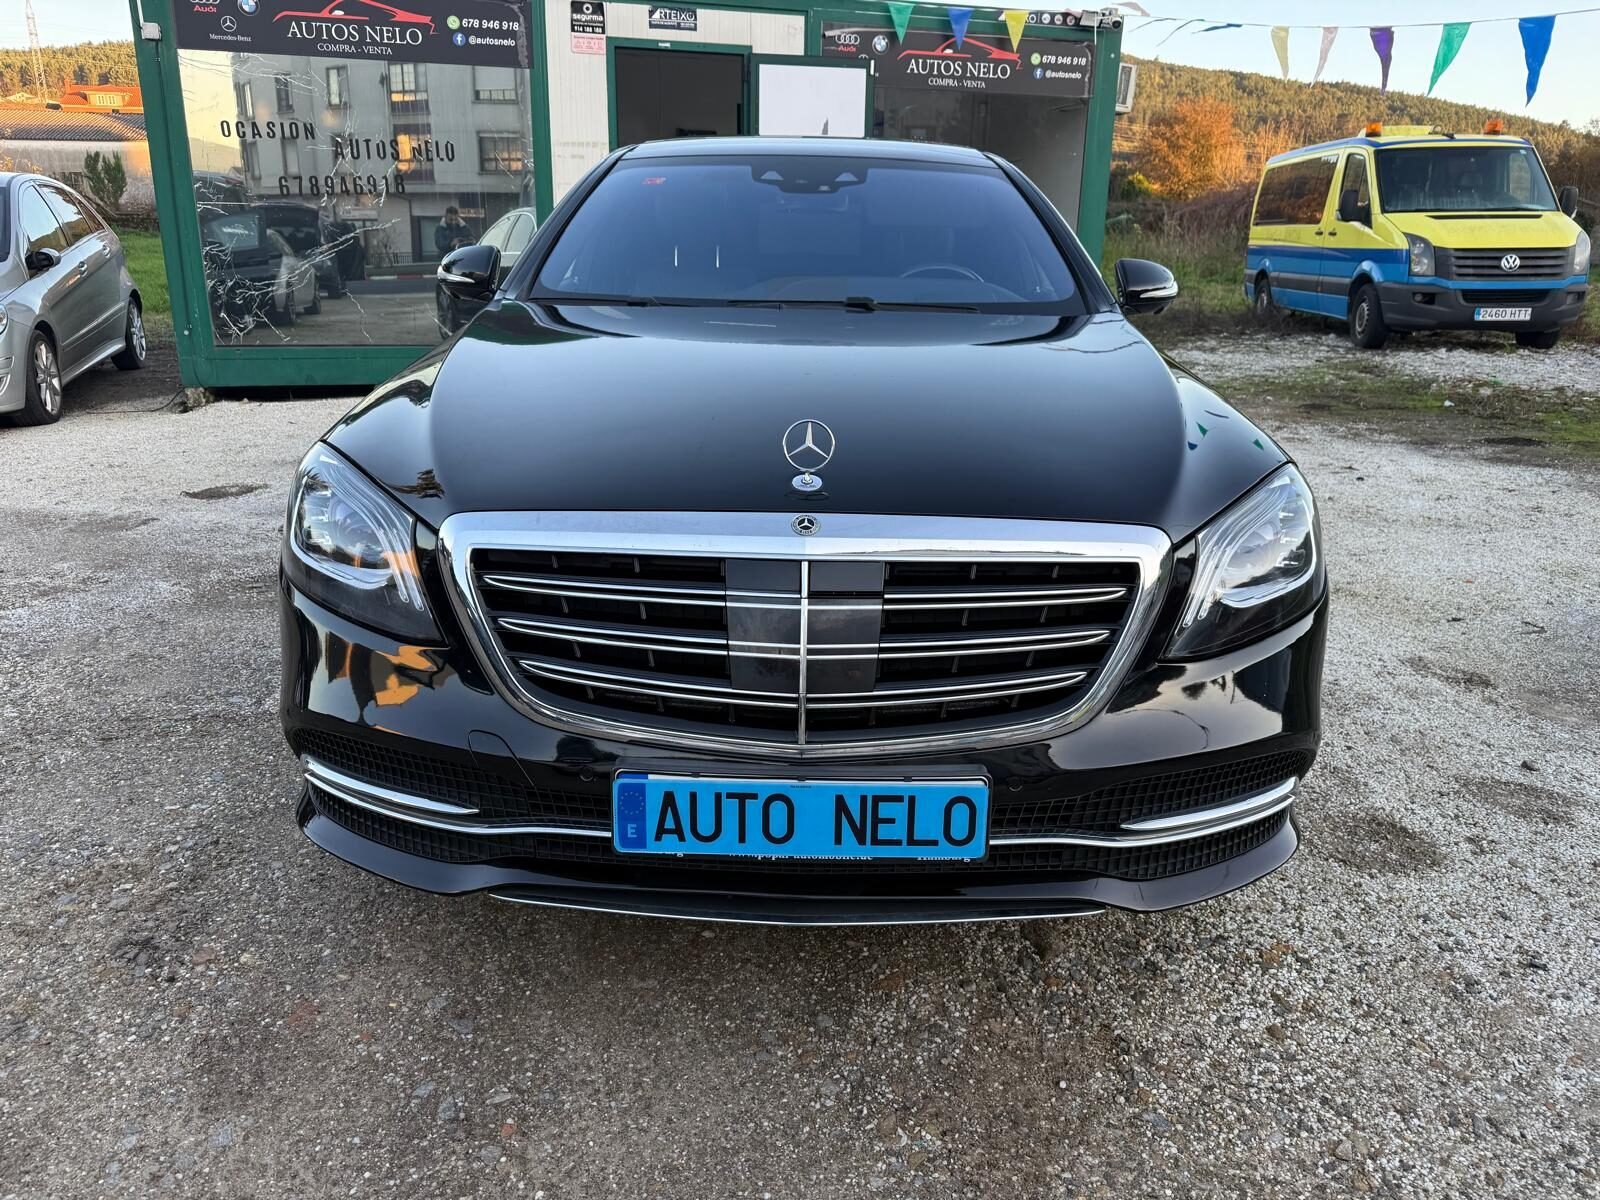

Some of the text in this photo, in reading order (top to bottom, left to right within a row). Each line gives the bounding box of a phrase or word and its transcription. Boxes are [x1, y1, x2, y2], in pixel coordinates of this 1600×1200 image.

[193, 4, 217, 13] Audi
[572, 13, 604, 22] segurma
[462, 18, 520, 31] 678 946 918
[209, 33, 252, 42] Mercedes-Benz
[287, 20, 423, 46] AUTOS NELO
[468, 35, 516, 47] @autosnelo
[317, 42, 356, 53] COMPRA
[362, 45, 393, 56] VENTA
[1042, 54, 1087, 66] 678 946 918
[906, 58, 1011, 80] AUTOS NELO
[1045, 68, 1082, 80] @autosnelo
[928, 77, 958, 88] COMPRA
[963, 79, 986, 89] VENTA
[220, 119, 316, 140] OCASION
[334, 137, 457, 163] AUTOS NELO
[277, 174, 406, 197] 678946918
[1481, 309, 1529, 319] 2460 HTT
[653, 790, 978, 848] AUTO NELO
[626, 824, 638, 838] E
